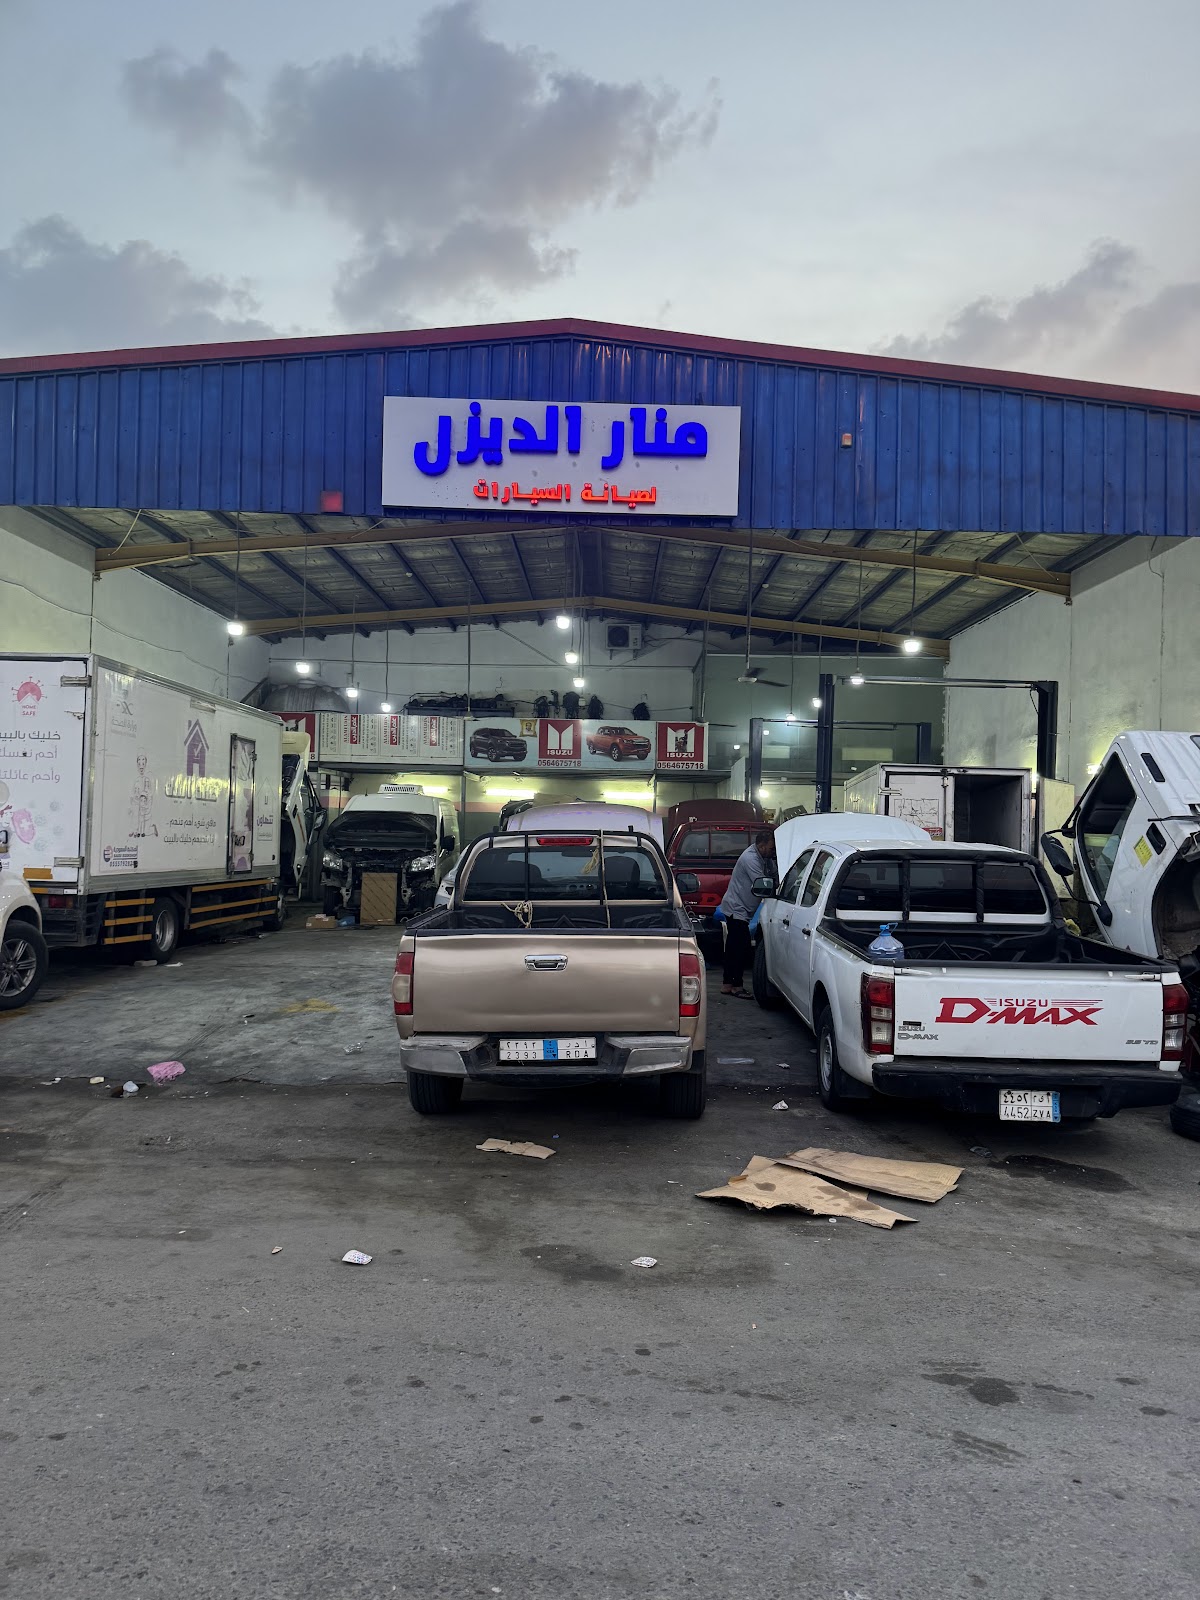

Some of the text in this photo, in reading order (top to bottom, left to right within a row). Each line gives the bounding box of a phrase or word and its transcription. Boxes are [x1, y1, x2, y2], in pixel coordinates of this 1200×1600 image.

[413, 401, 708, 477] منار الديزل
[472, 479, 657, 508] لصيانة السيارات
[28, 730, 60, 742] خليك
[0, 769, 28, 780] عائلت
[999, 998, 1048, 1007] ISUZU
[935, 998, 1104, 1026] D-MAX
[898, 1032, 938, 1040] D-MAX
[506, 1052, 537, 1060] 2393
[1004, 1106, 1030, 1118] 4452
